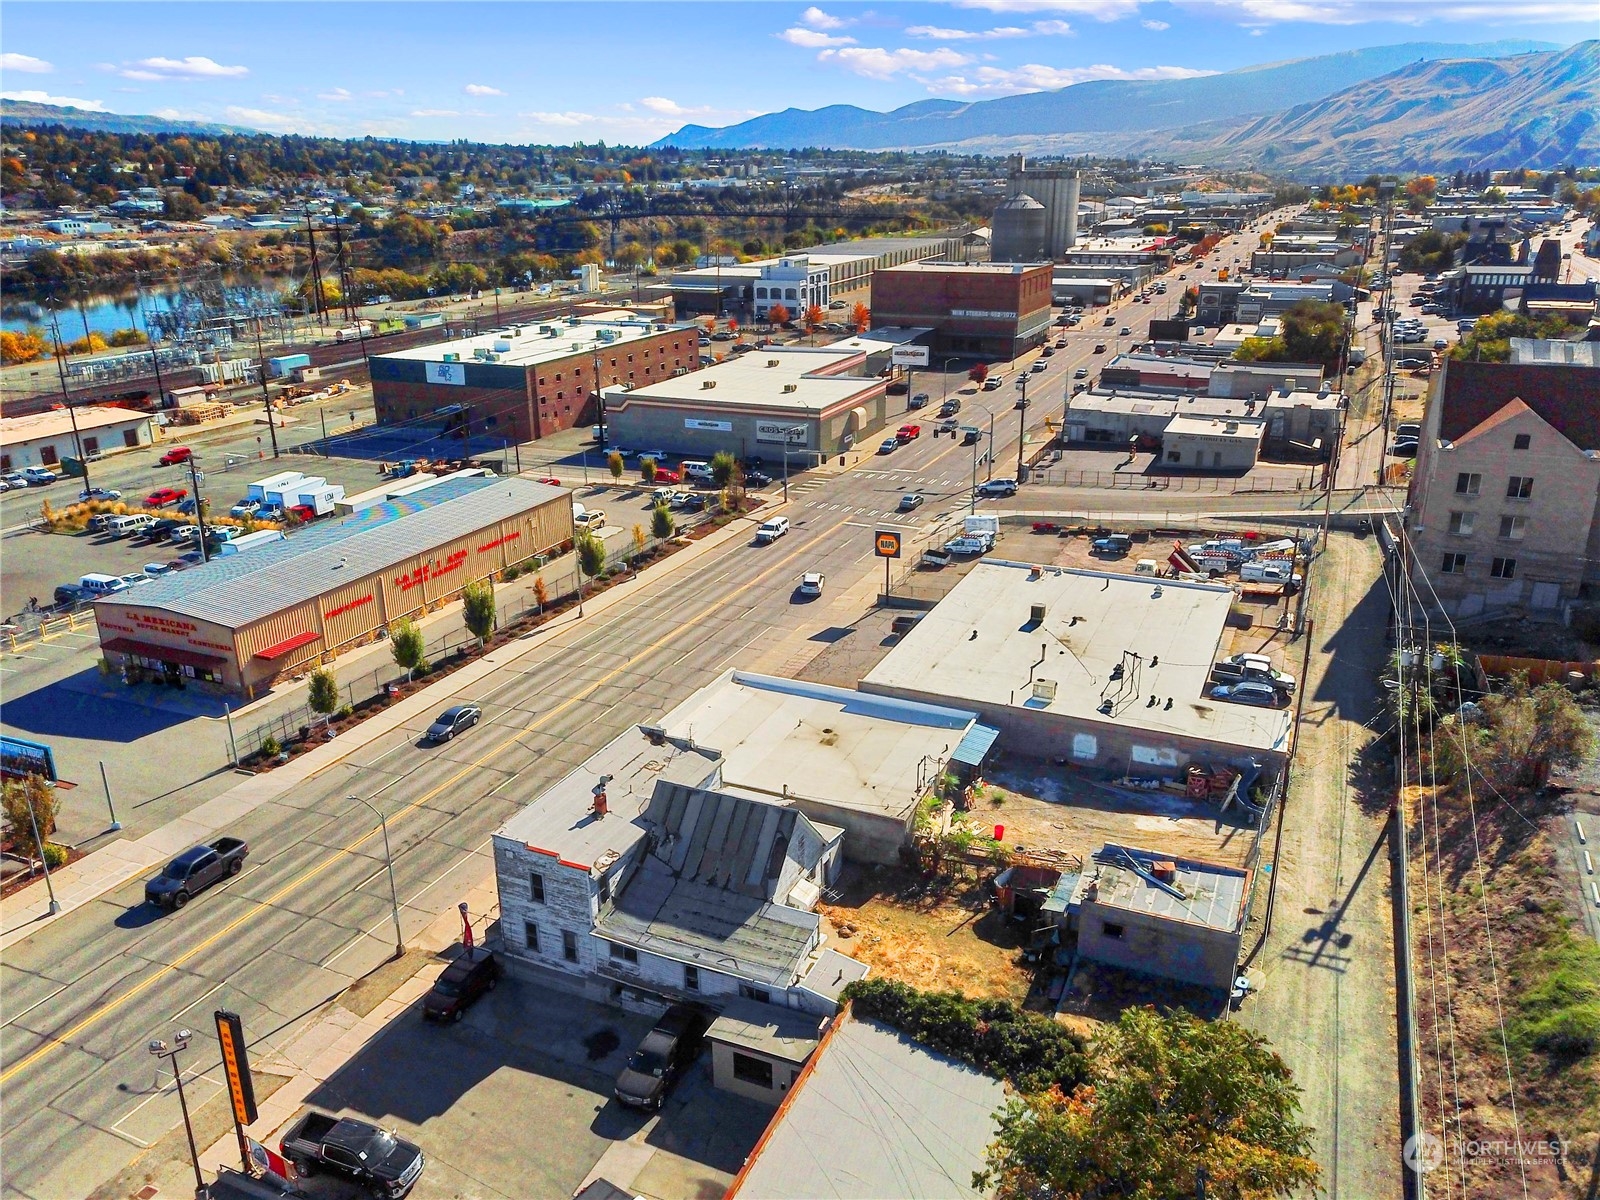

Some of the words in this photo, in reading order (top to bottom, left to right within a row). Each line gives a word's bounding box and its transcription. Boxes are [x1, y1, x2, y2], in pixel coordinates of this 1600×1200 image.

[880, 540, 895, 549] NAPA
[394, 573, 410, 586] LA
[126, 612, 140, 620] LA
[143, 615, 197, 632] MEXICANA
[136, 623, 159, 631] SUPER
[160, 627, 190, 637] MARKET
